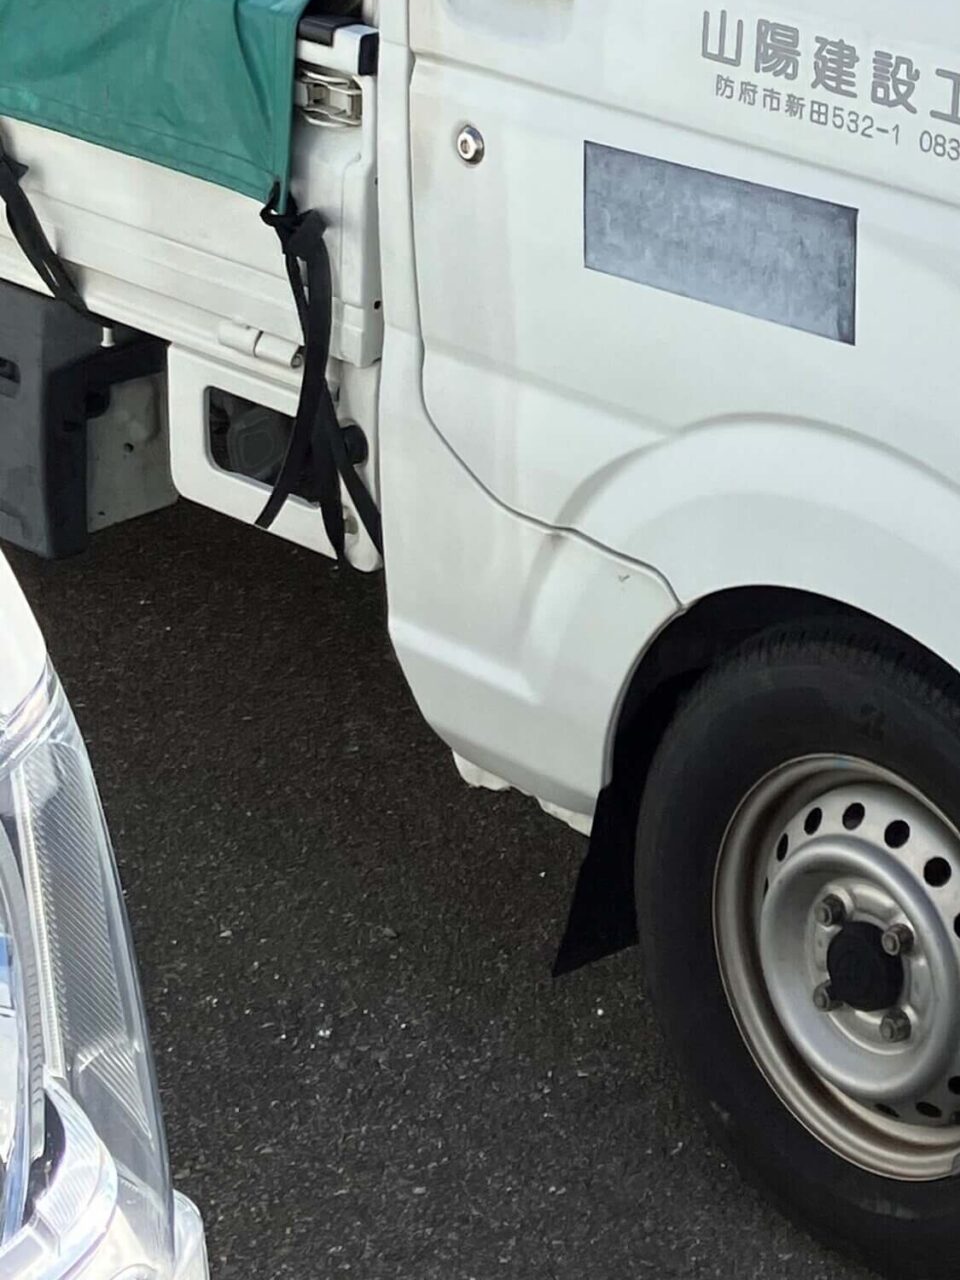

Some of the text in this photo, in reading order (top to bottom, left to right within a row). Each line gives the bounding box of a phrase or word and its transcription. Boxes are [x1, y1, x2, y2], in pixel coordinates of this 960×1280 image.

[715, 73, 900, 146] 防府市新田532-1
